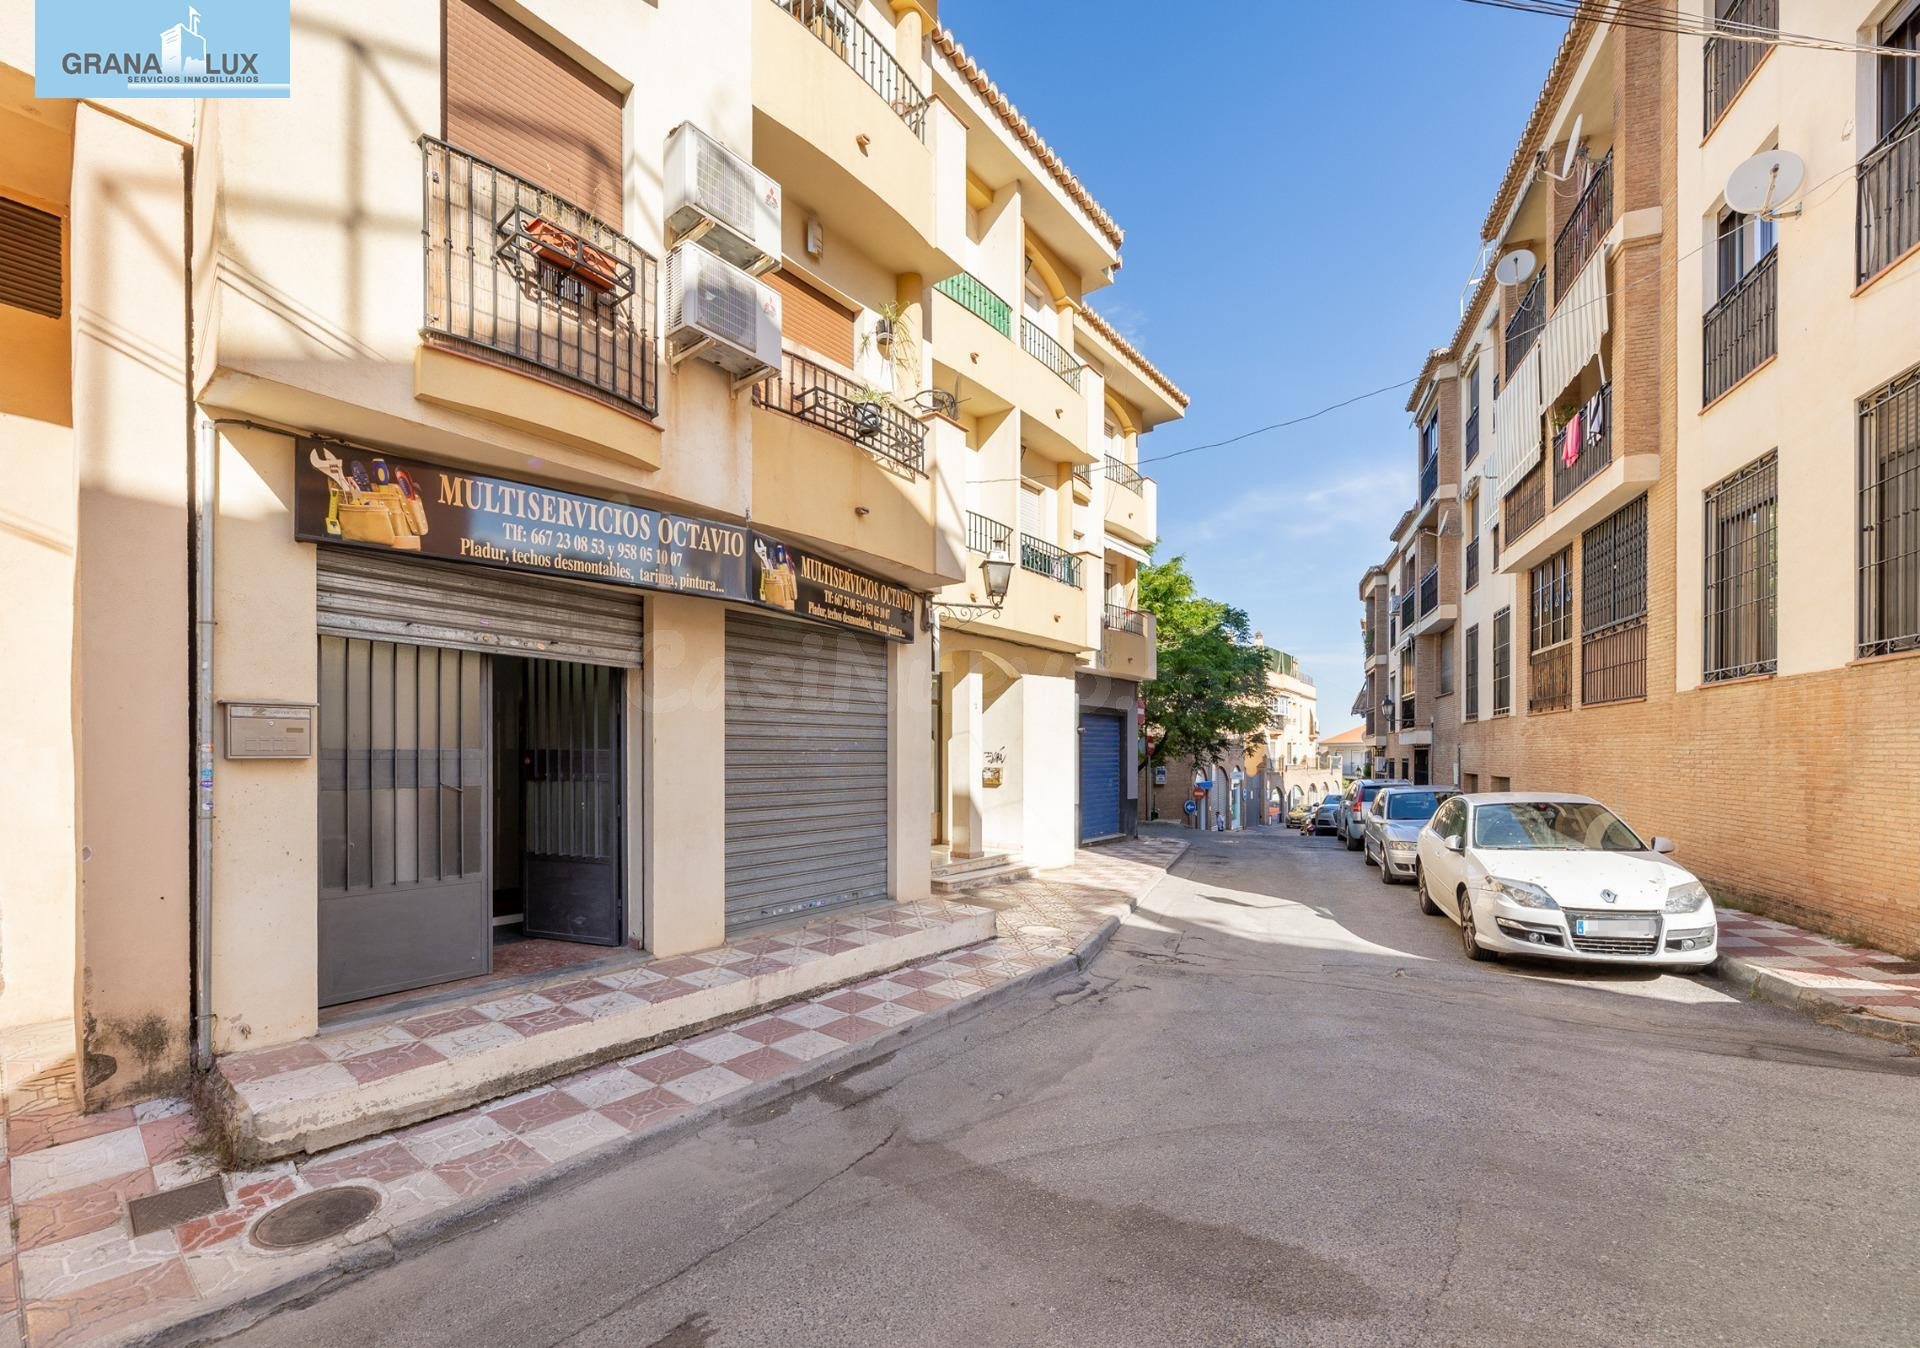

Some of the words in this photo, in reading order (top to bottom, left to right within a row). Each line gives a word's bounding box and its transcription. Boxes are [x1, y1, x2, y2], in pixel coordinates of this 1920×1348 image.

[437, 473, 651, 541] MULTISERVICIOS
[658, 517, 745, 558] OCTAVIO
[460, 537, 510, 565] Pladur,
[512, 547, 551, 568] techos
[554, 553, 635, 582] desmontables,
[639, 567, 678, 589] tarima,
[680, 573, 725, 593] pintura...
[502, 522, 527, 543] Tlf:
[530, 527, 553, 546] 667
[556, 531, 571, 550] 23
[573, 534, 589, 553] 08
[591, 538, 605, 555] 53
[604, 545, 615, 561] y
[617, 542, 637, 561] 958
[639, 546, 653, 563] 05
[656, 549, 668, 566] 10
[670, 551, 683, 567] 07
[801, 555, 879, 601] MULTISERVICIOS
[880, 584, 913, 612] OCTAVIO
